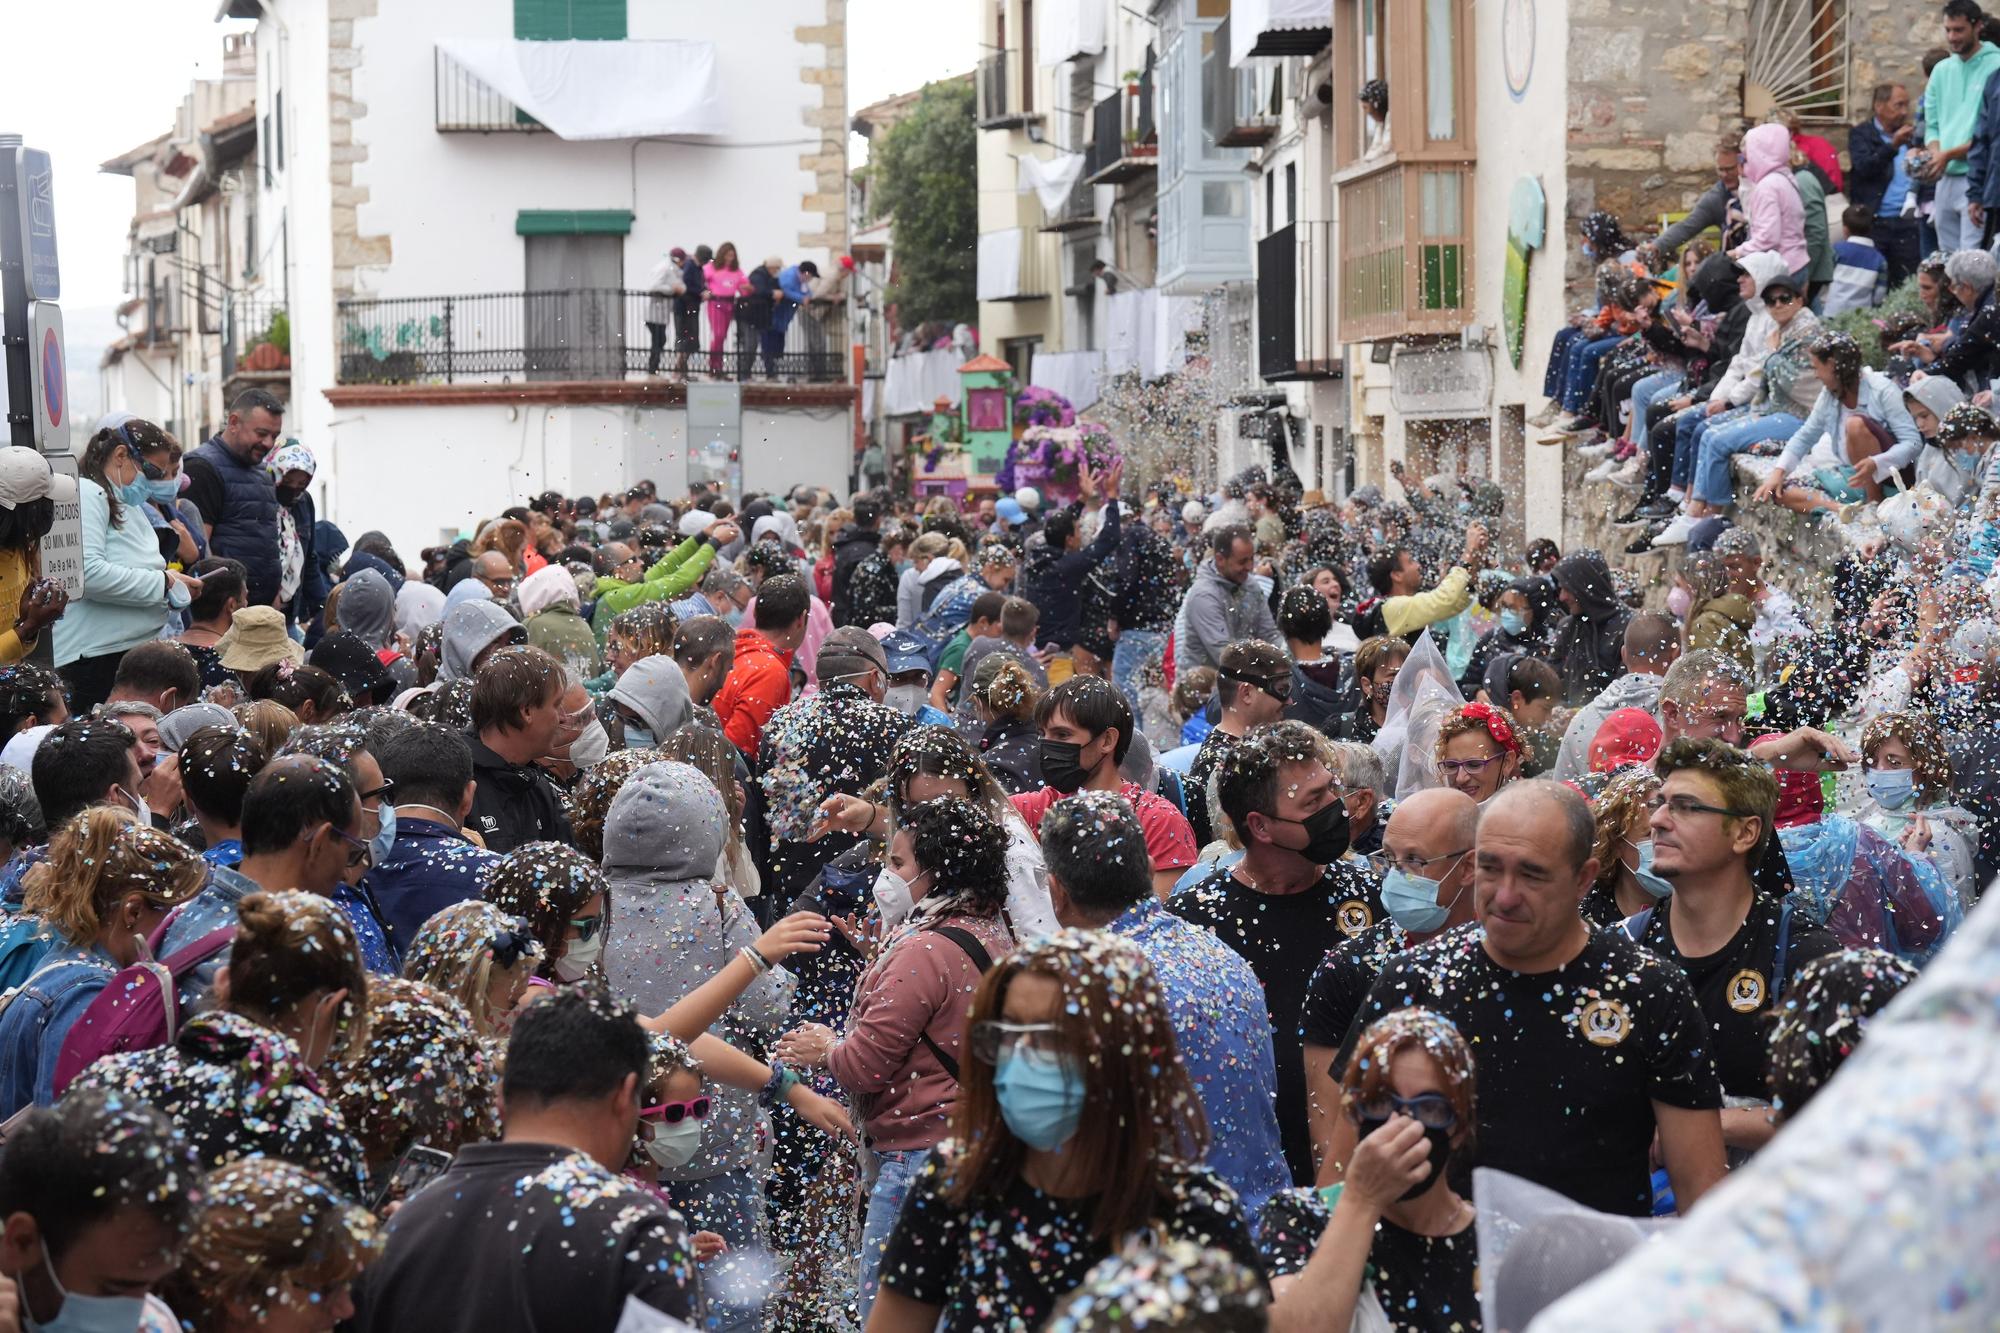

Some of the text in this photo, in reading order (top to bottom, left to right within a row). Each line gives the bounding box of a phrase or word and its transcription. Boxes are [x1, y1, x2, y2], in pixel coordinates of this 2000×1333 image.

[55, 503, 79, 520] RIZADOS
[44, 532, 79, 550] 30 MIN. MAX.
[49, 560, 56, 573] De
[57, 559, 61, 572] 9
[62, 561, 66, 571] a
[66, 558, 72, 571] 14
